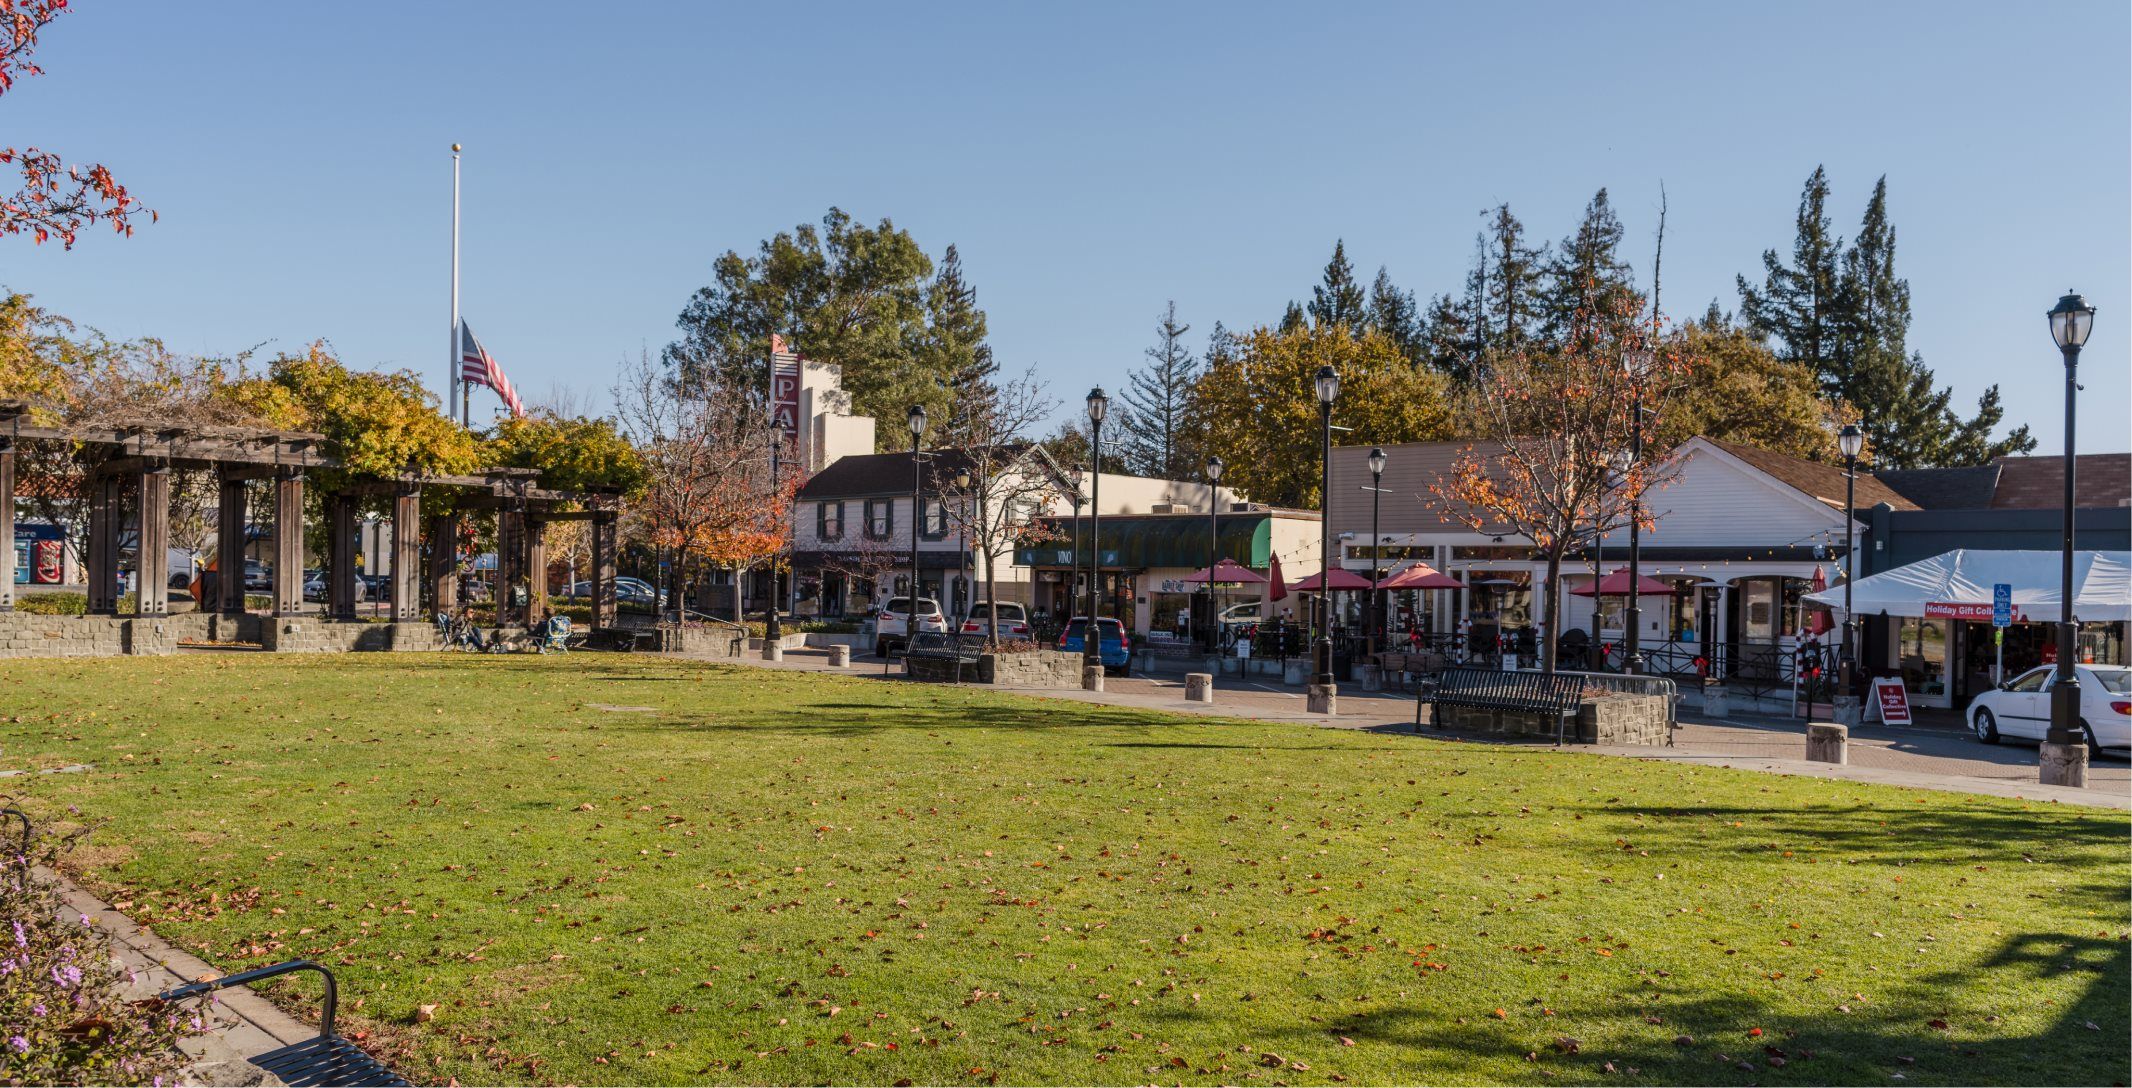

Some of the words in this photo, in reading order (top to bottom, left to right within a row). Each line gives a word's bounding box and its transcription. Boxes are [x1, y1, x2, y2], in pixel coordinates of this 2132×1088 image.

[1057, 550, 1072, 564] VINO
[1926, 604, 1957, 616] Holiday
[1958, 606, 1974, 615] Gift
[1975, 607, 2017, 615] Colle
